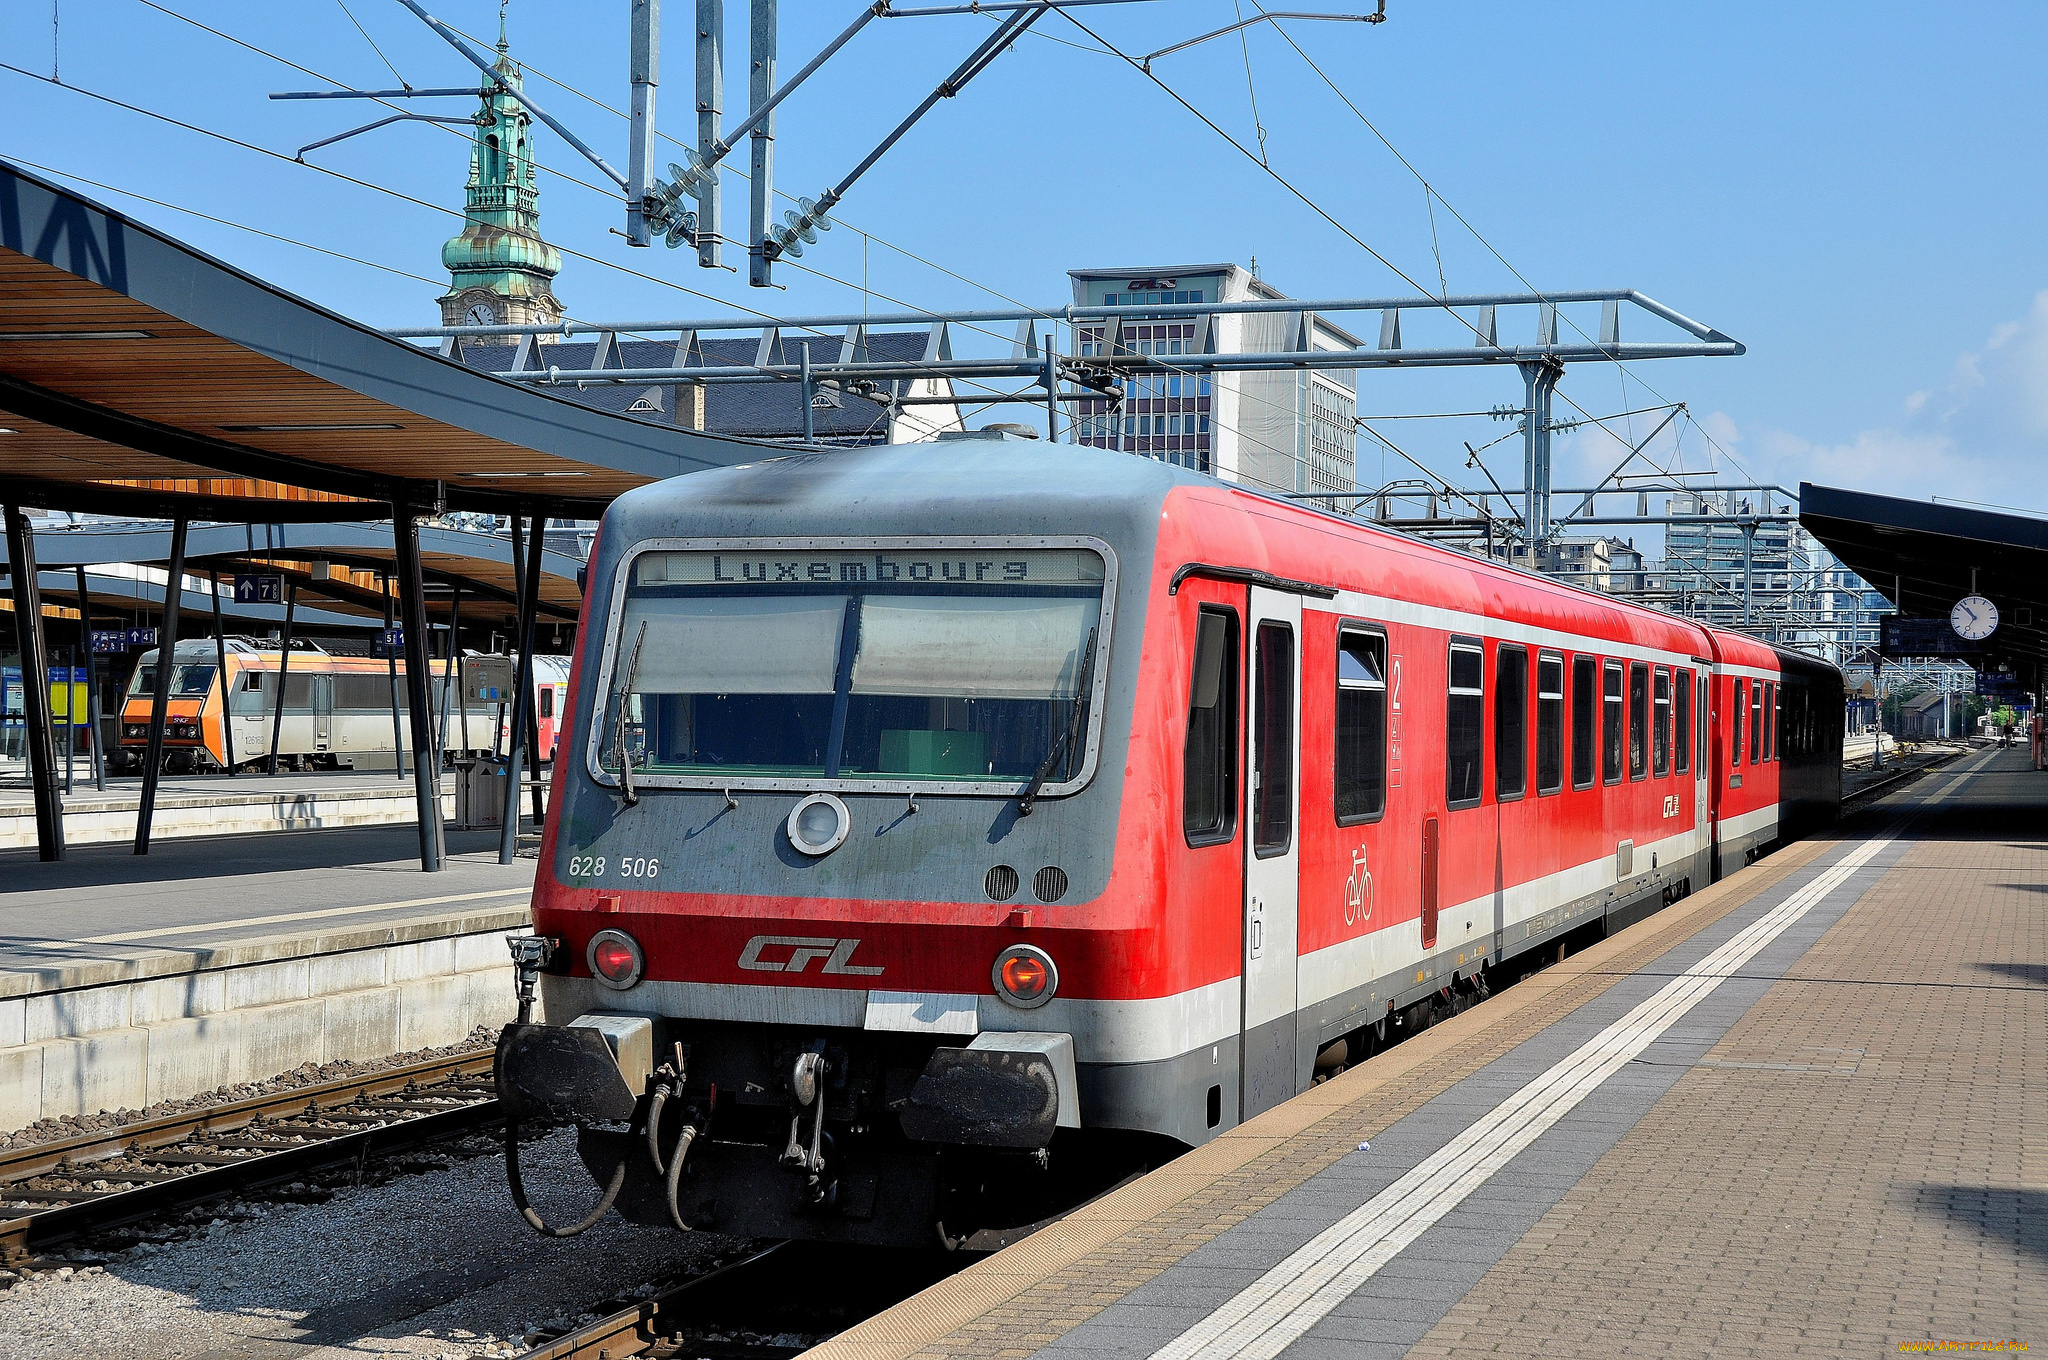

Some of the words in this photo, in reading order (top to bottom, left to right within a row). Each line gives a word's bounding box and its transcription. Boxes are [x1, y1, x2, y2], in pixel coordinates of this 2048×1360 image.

[712, 555, 1029, 582] Luxembourg
[261, 584, 270, 598] 7
[143, 633, 149, 641] 4
[386, 634, 392, 643] 5
[1393, 660, 1401, 710] 2
[173, 717, 190, 725] SNCF
[568, 855, 606, 877] 628
[620, 857, 660, 879] 506
[737, 935, 886, 976] CFL
